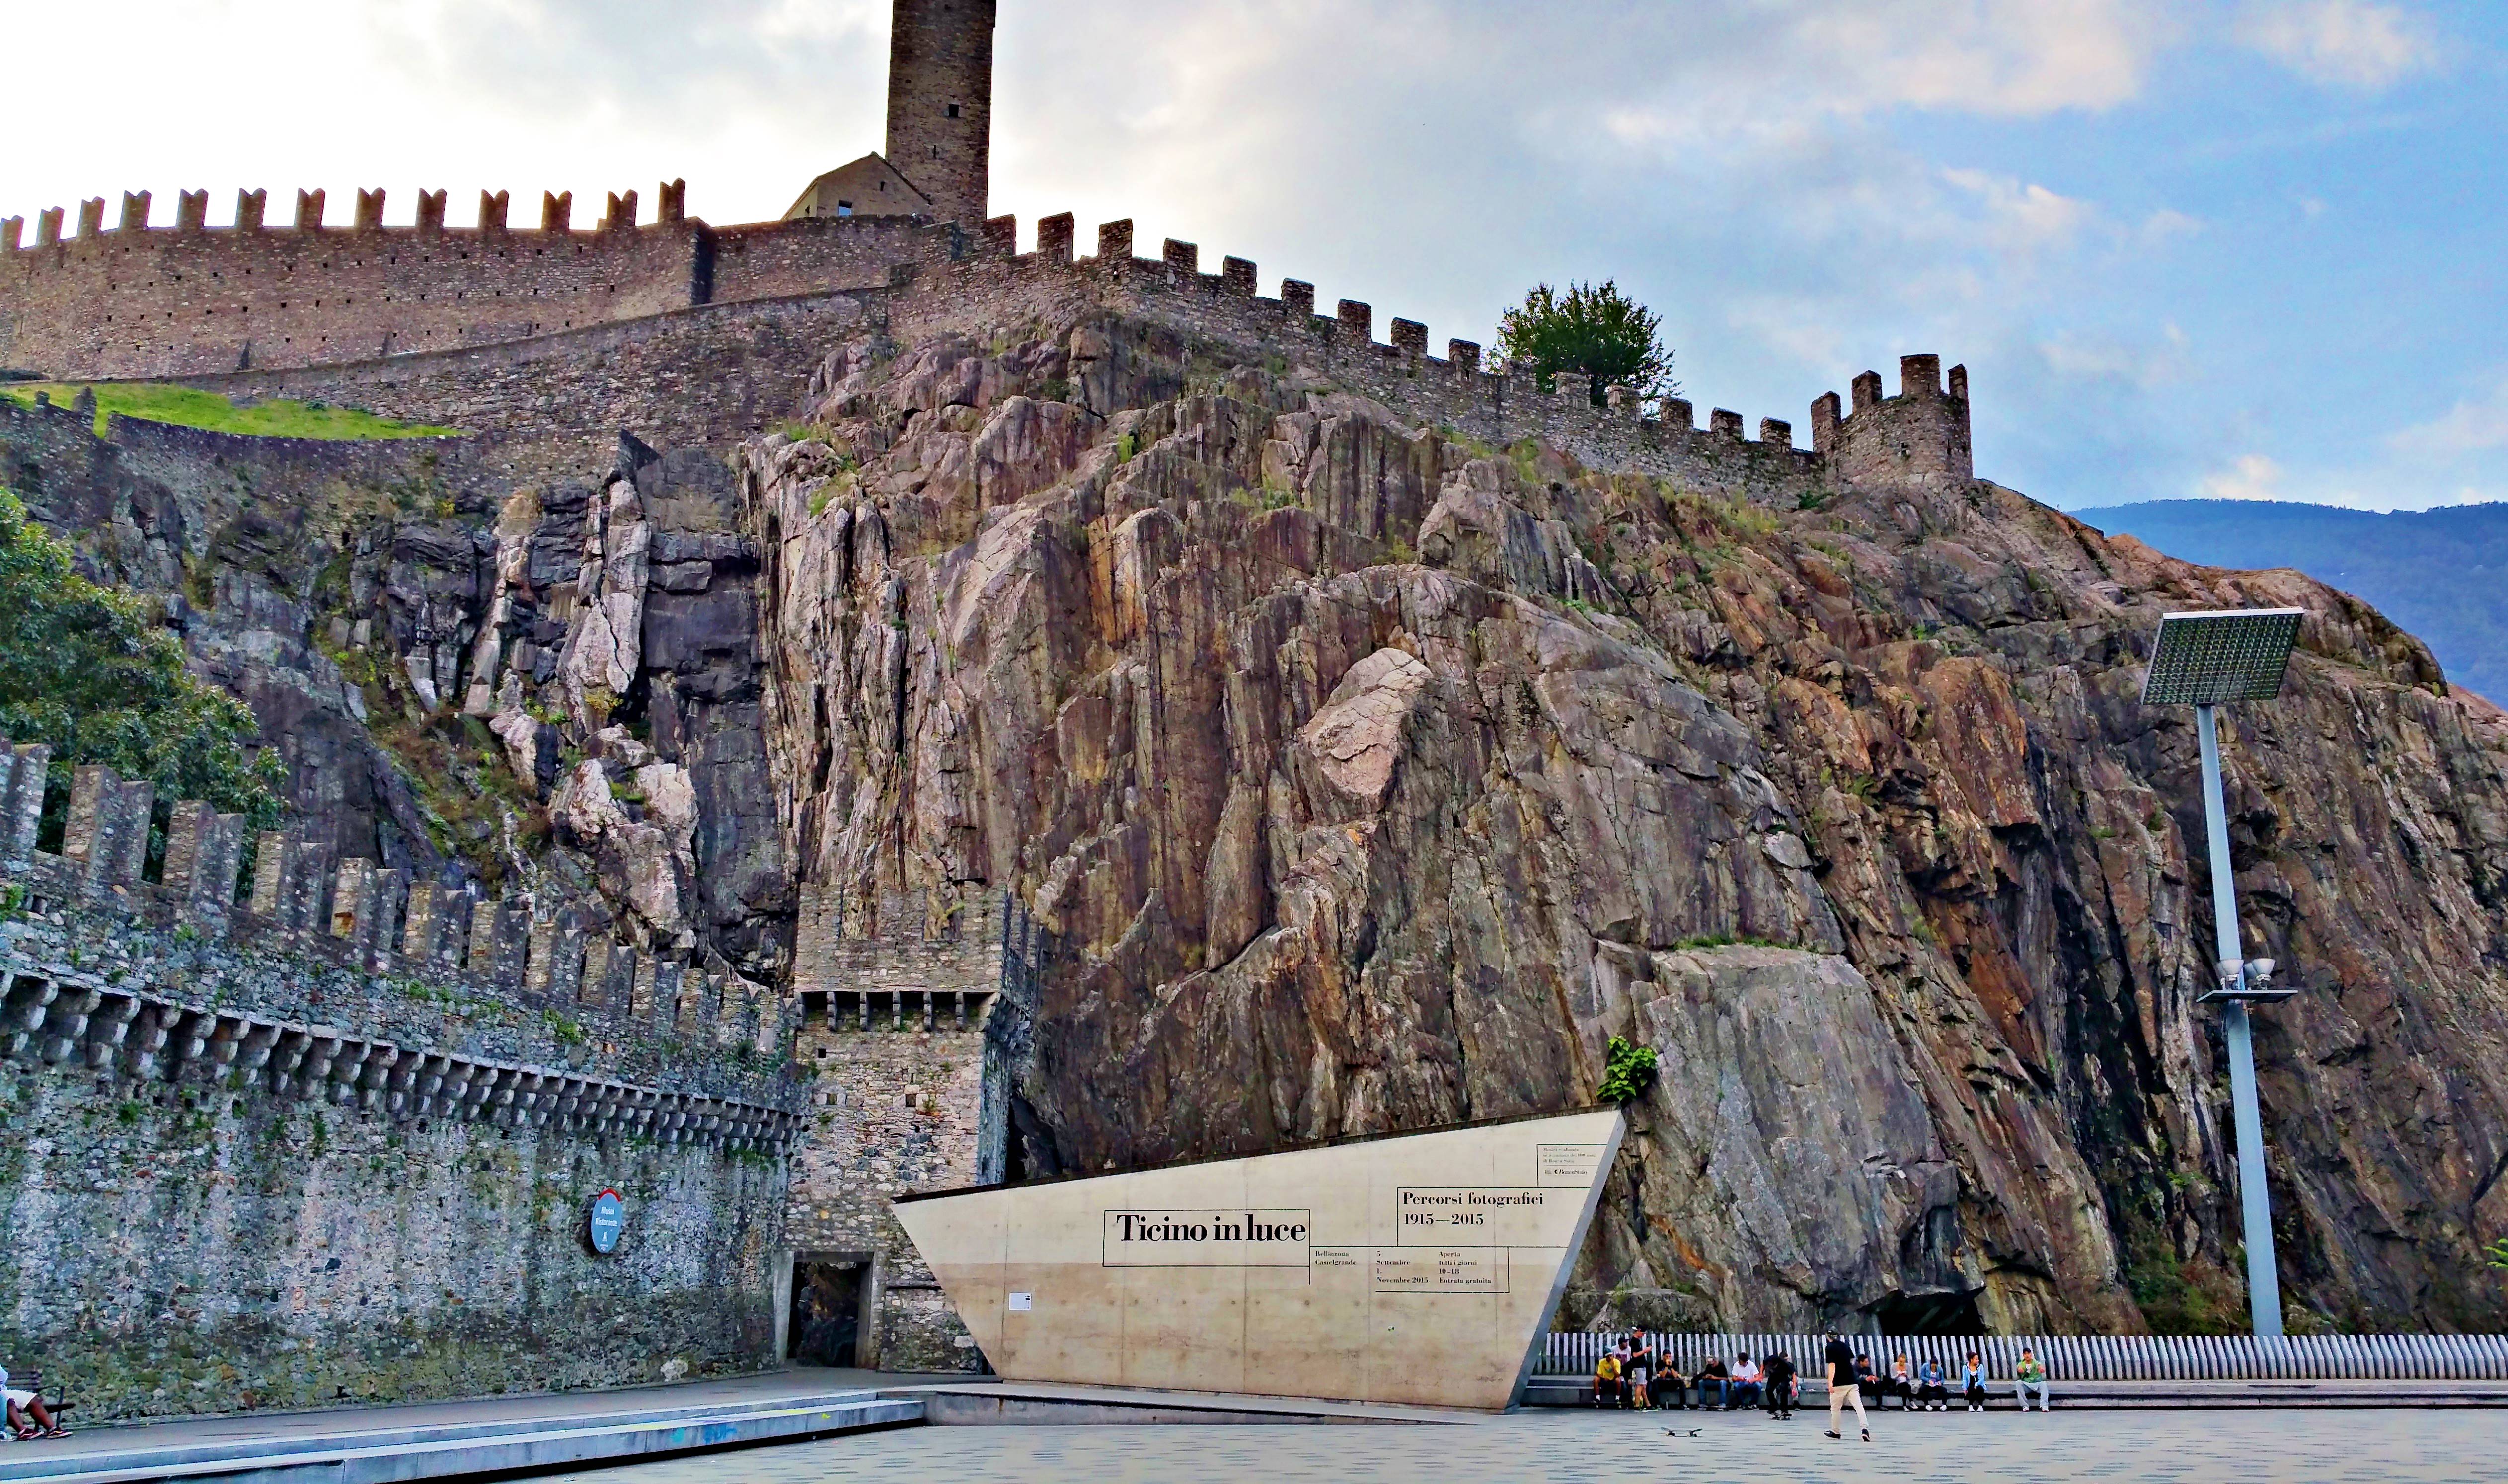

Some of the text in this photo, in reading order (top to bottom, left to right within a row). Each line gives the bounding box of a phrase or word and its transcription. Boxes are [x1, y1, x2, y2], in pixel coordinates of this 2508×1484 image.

[1403, 1192, 1544, 1208] Percorsi fotografici
[1116, 1213, 1306, 1241] Ticino in luce
